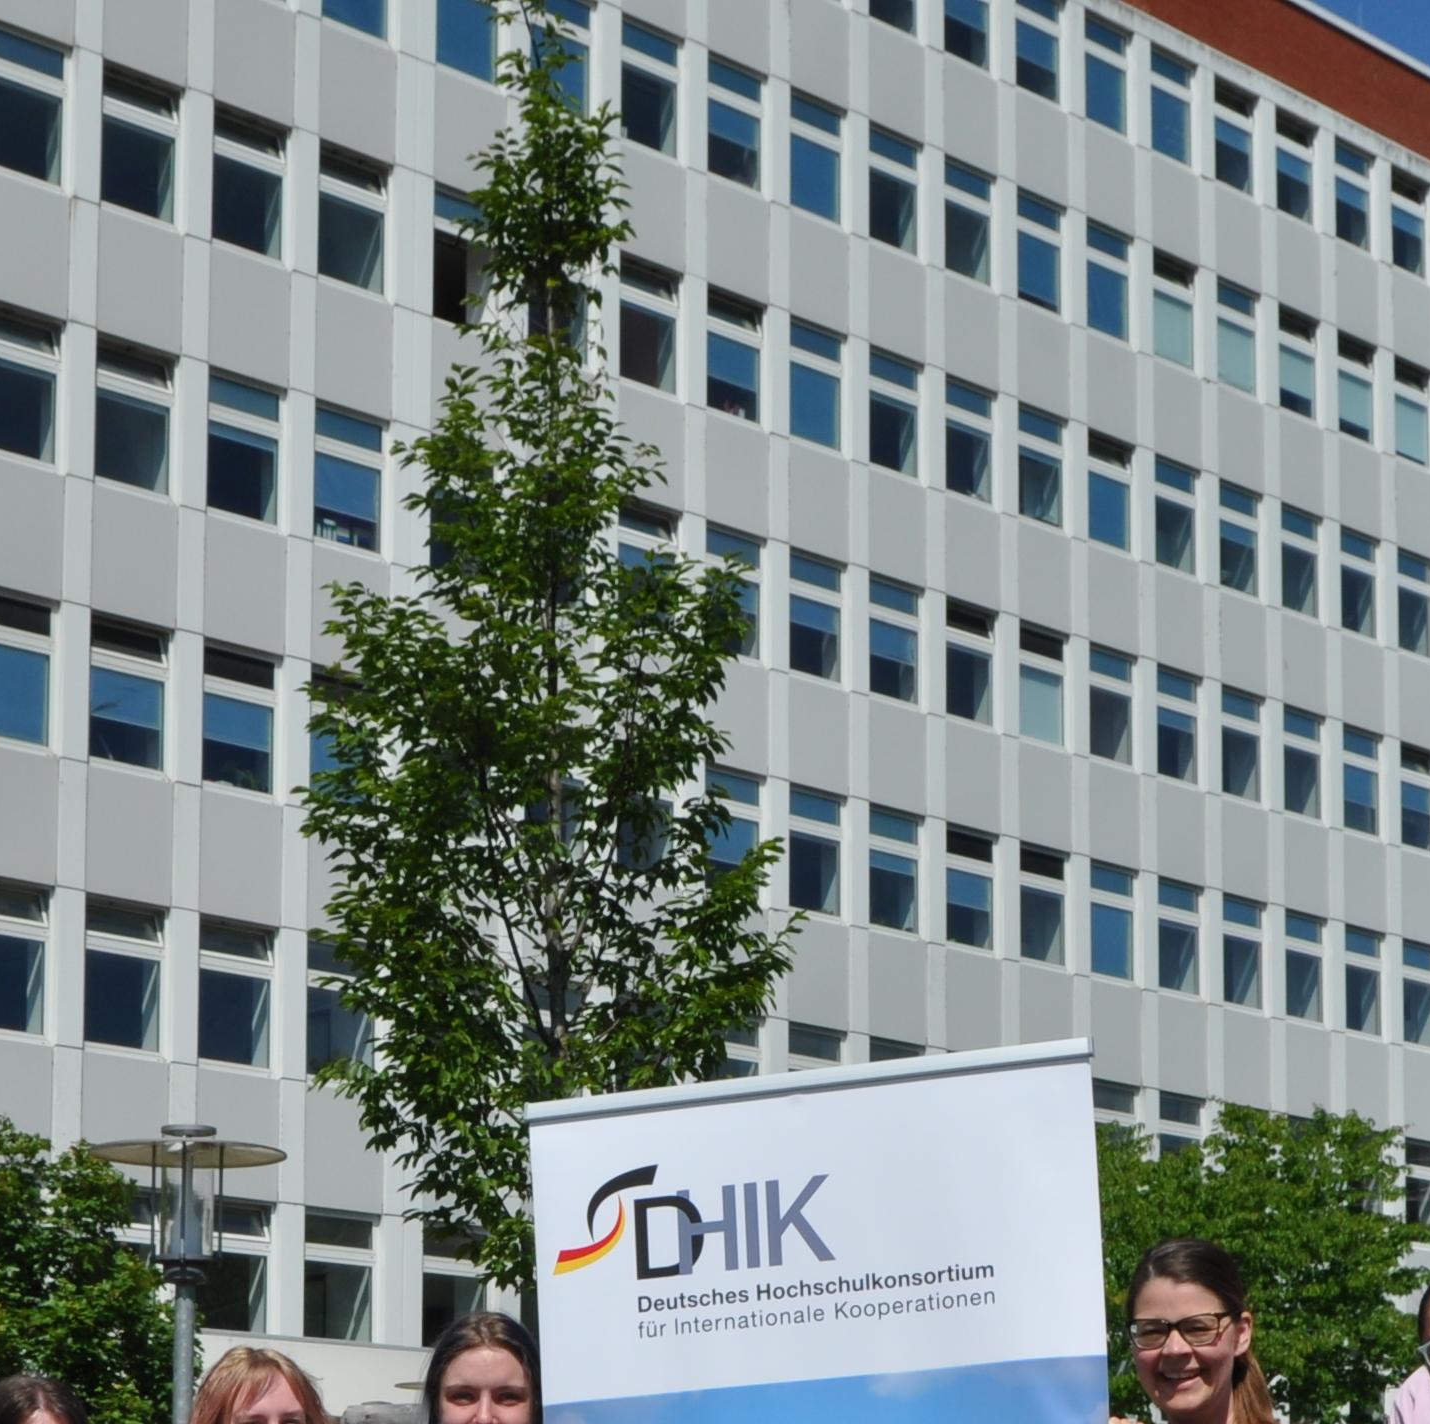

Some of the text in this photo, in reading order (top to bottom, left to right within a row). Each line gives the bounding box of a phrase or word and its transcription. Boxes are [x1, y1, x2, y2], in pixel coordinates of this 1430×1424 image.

[633, 1173, 837, 1281] DHIK
[637, 1263, 995, 1313] Deutsches Hochschulkonsortium
[638, 1290, 996, 1339] für Internationale Kooperationen
